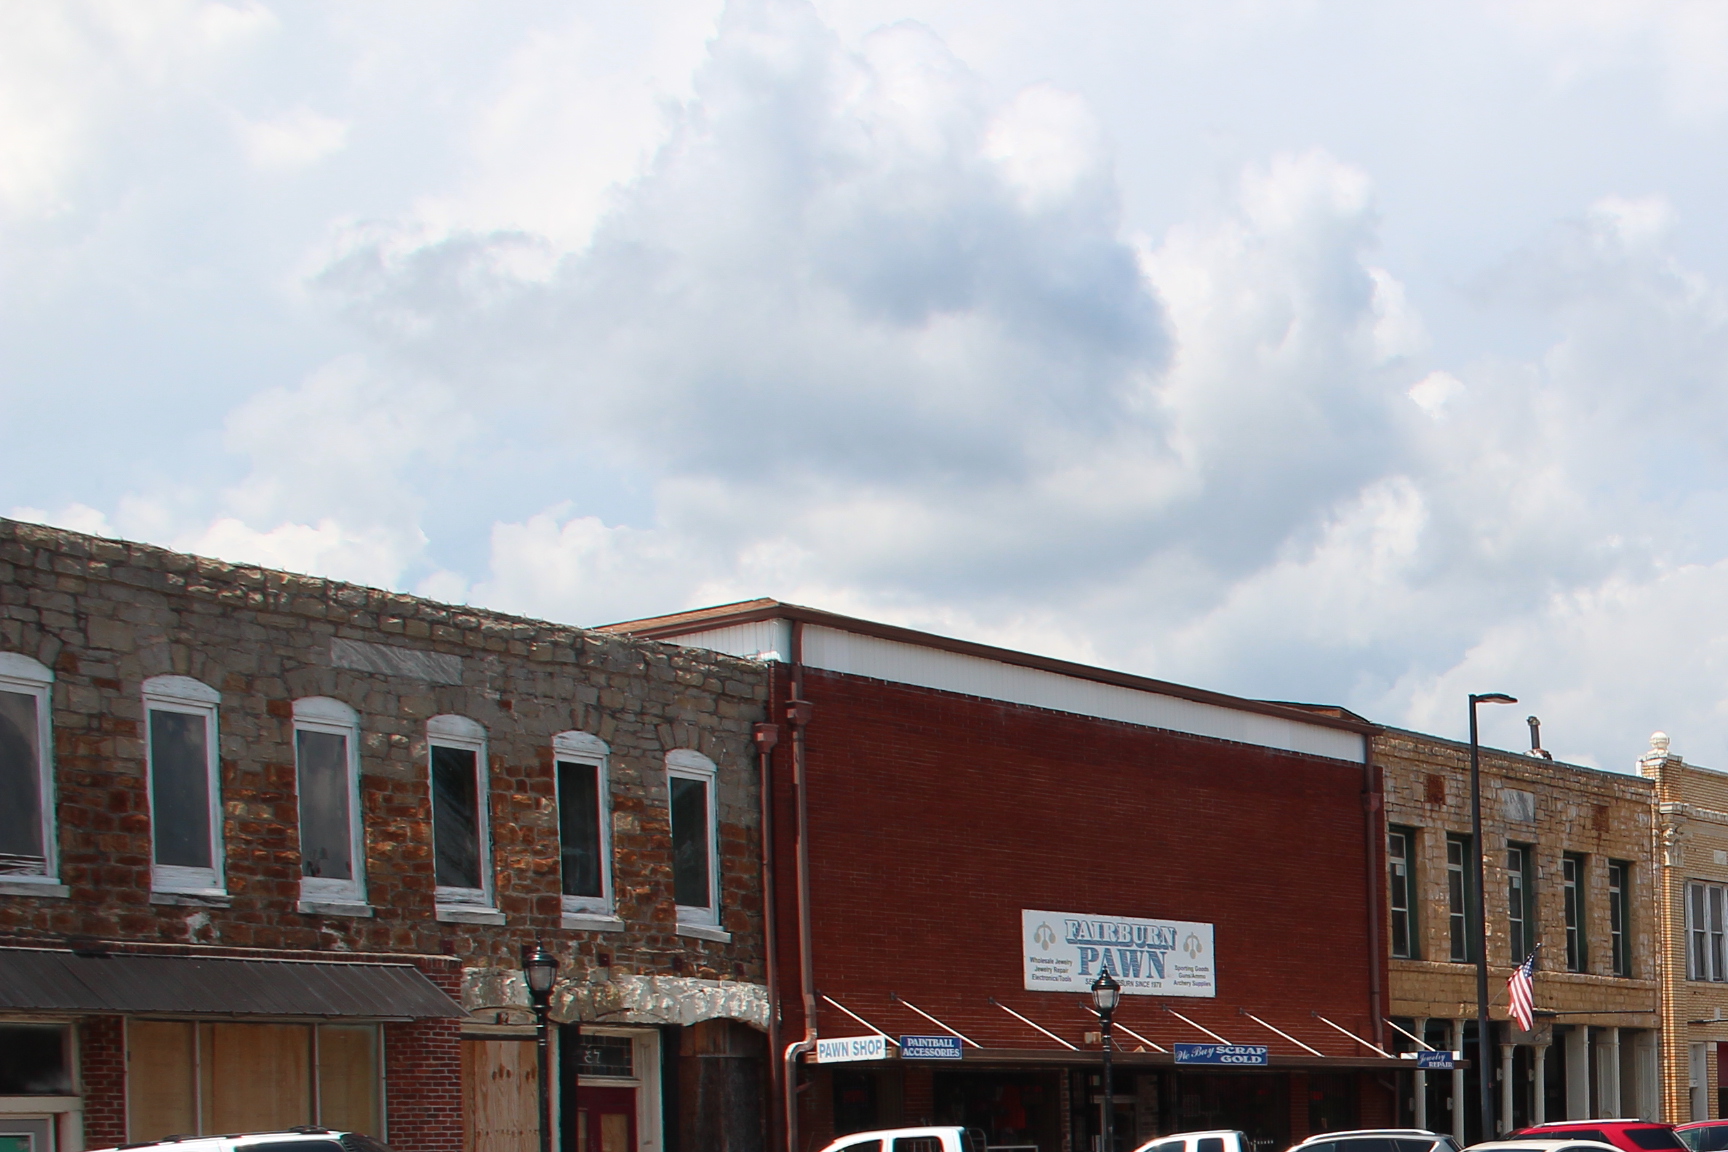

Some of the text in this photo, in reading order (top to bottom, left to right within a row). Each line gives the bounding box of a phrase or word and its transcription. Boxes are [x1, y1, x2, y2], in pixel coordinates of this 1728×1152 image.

[1064, 919, 1178, 950] FAIRBURN
[1029, 956, 1073, 967] Wholesale Jewelry
[1077, 946, 1168, 979] PAWN
[1034, 965, 1069, 974] Jewelry Repair
[1174, 964, 1194, 972] Sporting
[1135, 980, 1150, 988] SINCE
[1192, 980, 1211, 988] Supplies
[907, 1037, 954, 1048] PAINTBALL
[819, 1039, 883, 1058] PAWN SHOP
[902, 1047, 960, 1057] ACCESSORIES
[1176, 1046, 1267, 1061] We Buy SCRAP
[1220, 1055, 1262, 1063] GOLD
